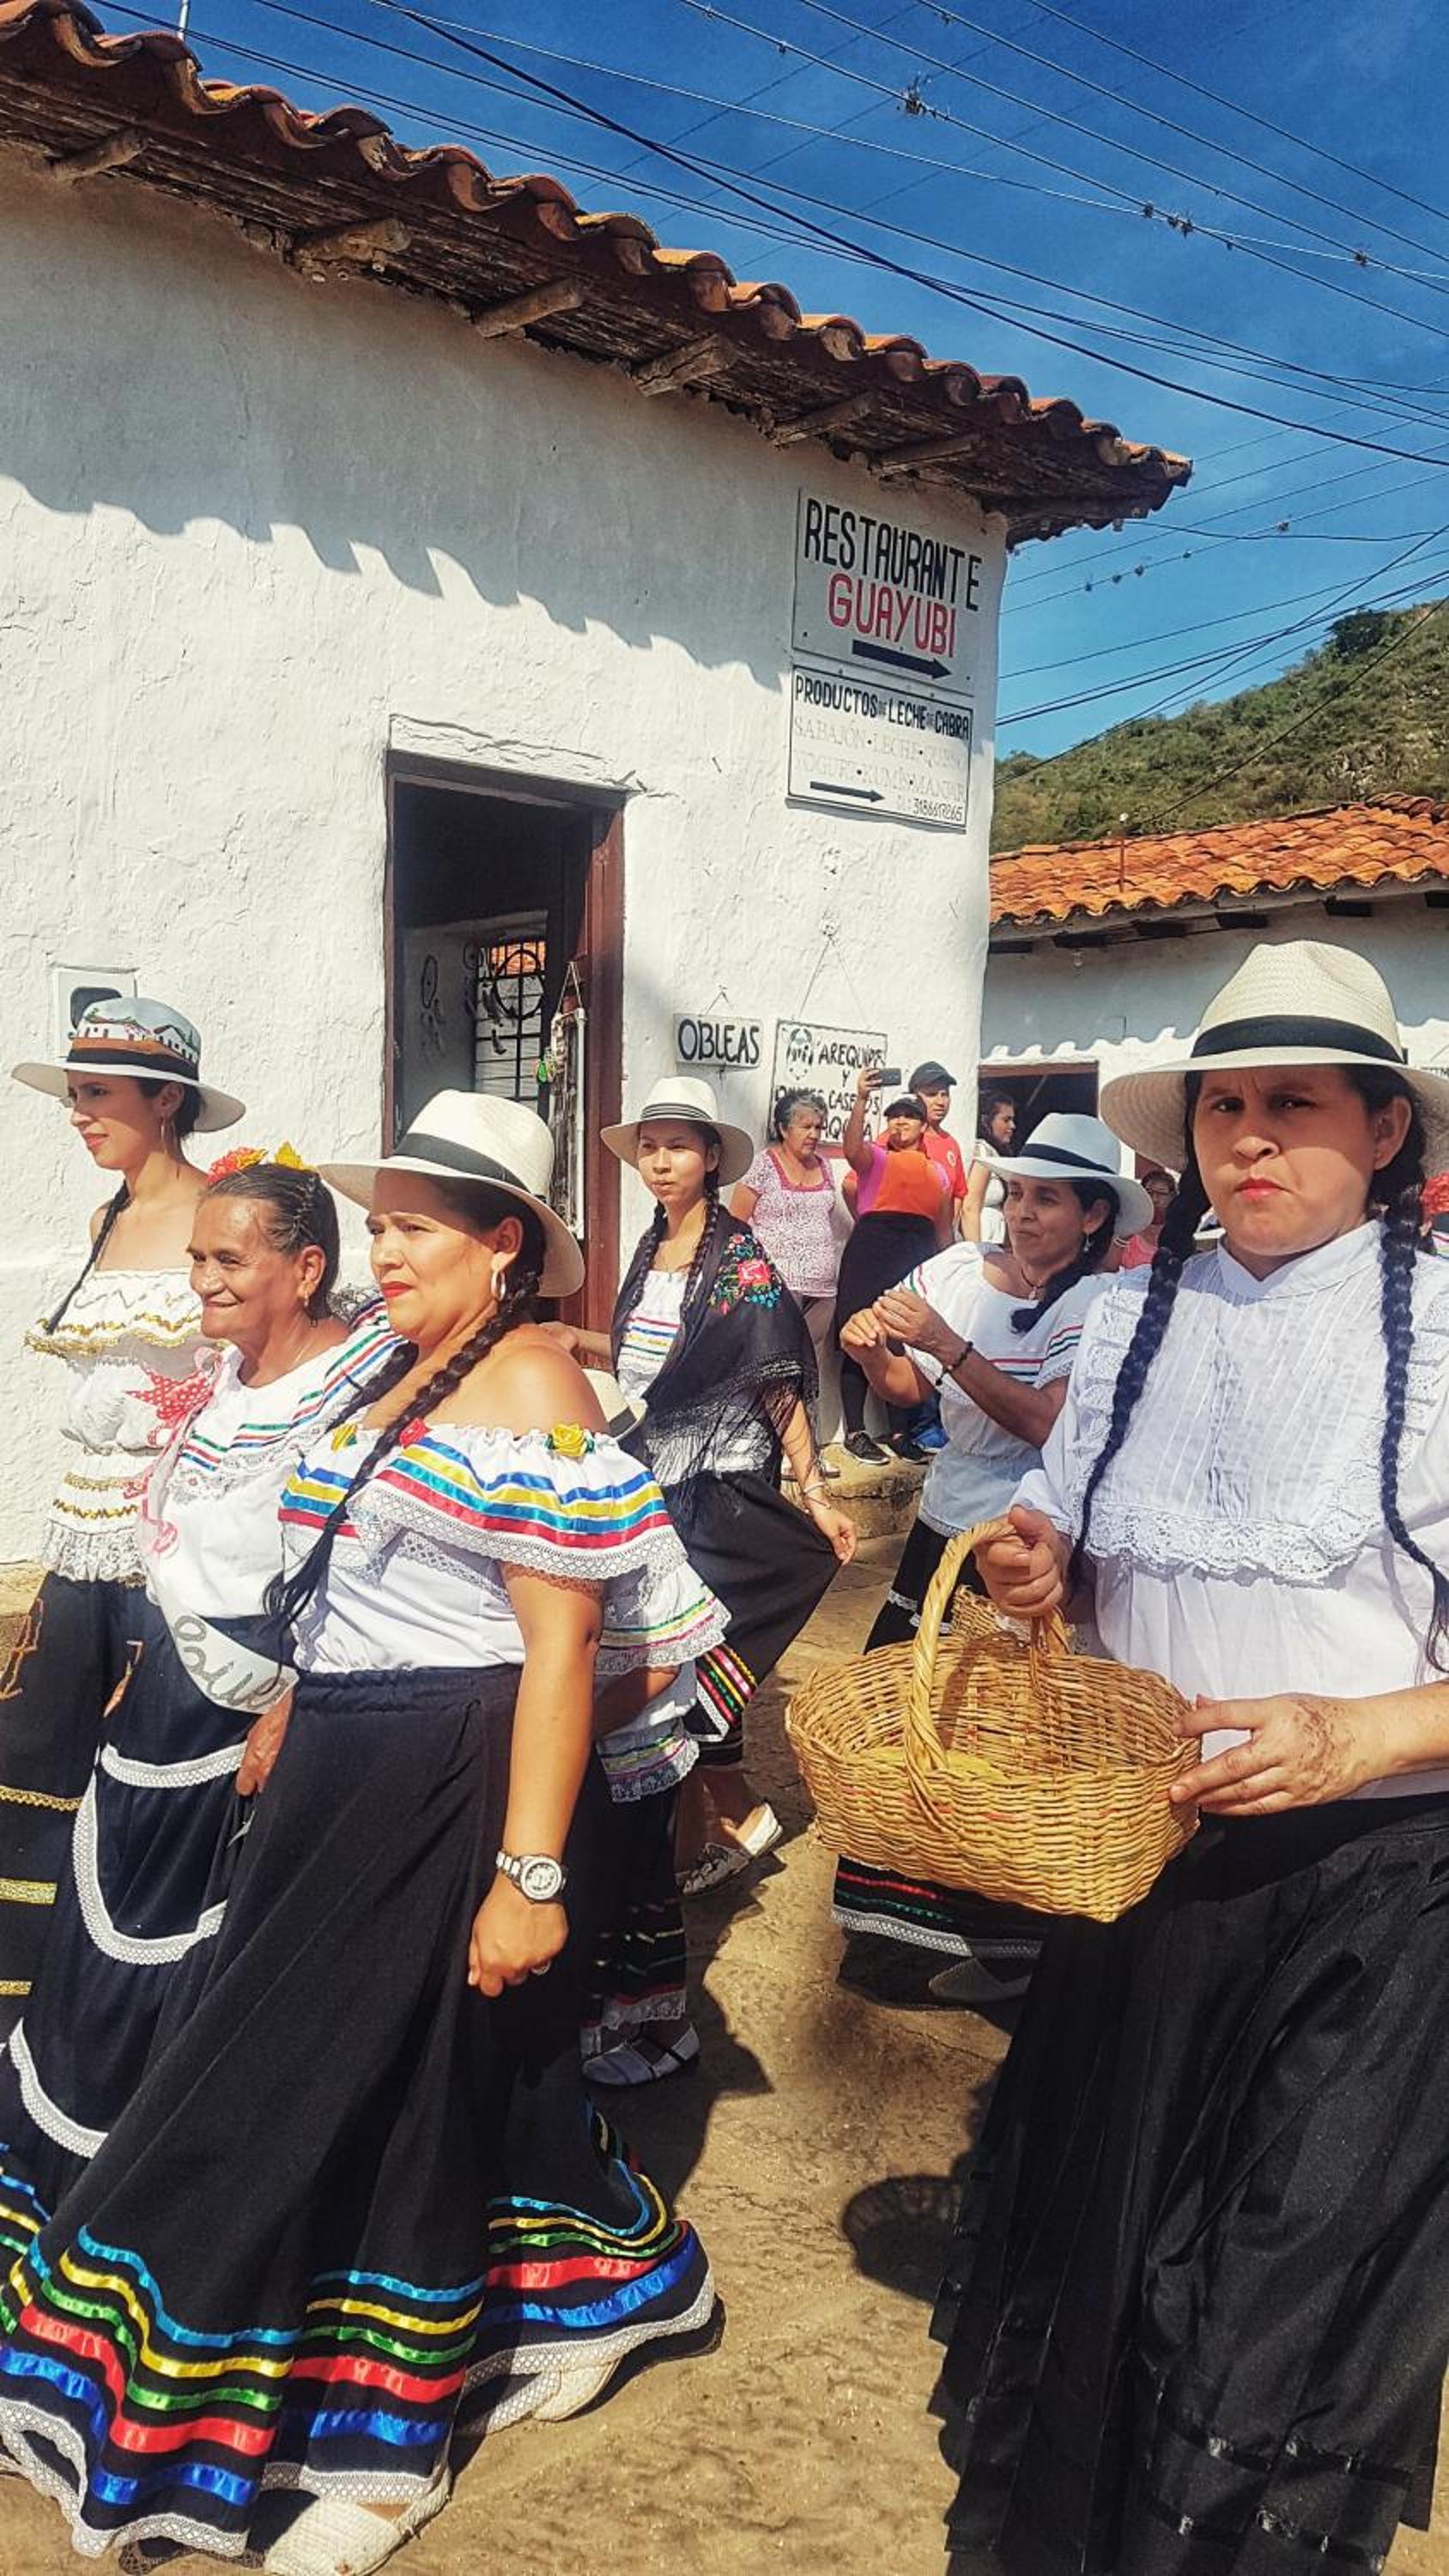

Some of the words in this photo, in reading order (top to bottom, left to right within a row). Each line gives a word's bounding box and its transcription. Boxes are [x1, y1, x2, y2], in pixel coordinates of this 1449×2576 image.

[804, 497, 982, 611] RESTAURANTE
[828, 572, 956, 658] GUAYUBI
[795, 674, 878, 718] PRODUCTOS
[888, 698, 927, 731] LECHE
[935, 710, 969, 740] CABRA
[678, 1018, 760, 1065] OBLEAS
[842, 1069, 851, 1088] Y
